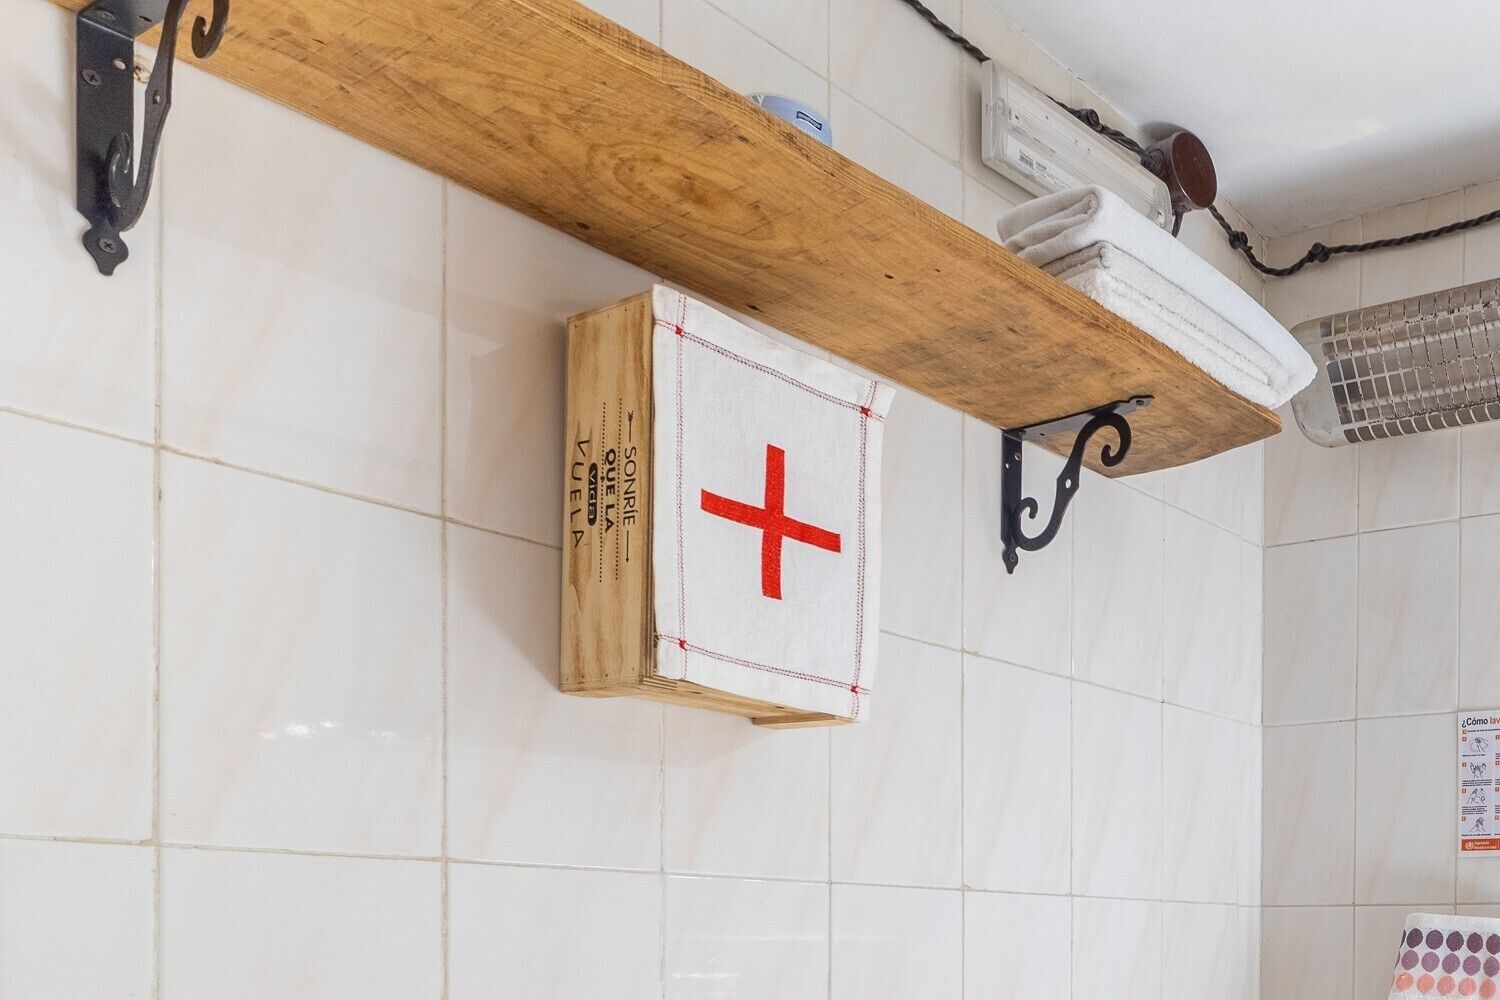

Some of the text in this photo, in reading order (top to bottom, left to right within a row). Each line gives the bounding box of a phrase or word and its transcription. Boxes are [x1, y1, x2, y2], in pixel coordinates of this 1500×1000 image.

[570, 440, 590, 549] VUELA
[589, 470, 597, 519] vida
[605, 448, 616, 533] QUE LA
[623, 446, 639, 526] SONRÍE
[1461, 716, 1488, 728] ¿Cómo
